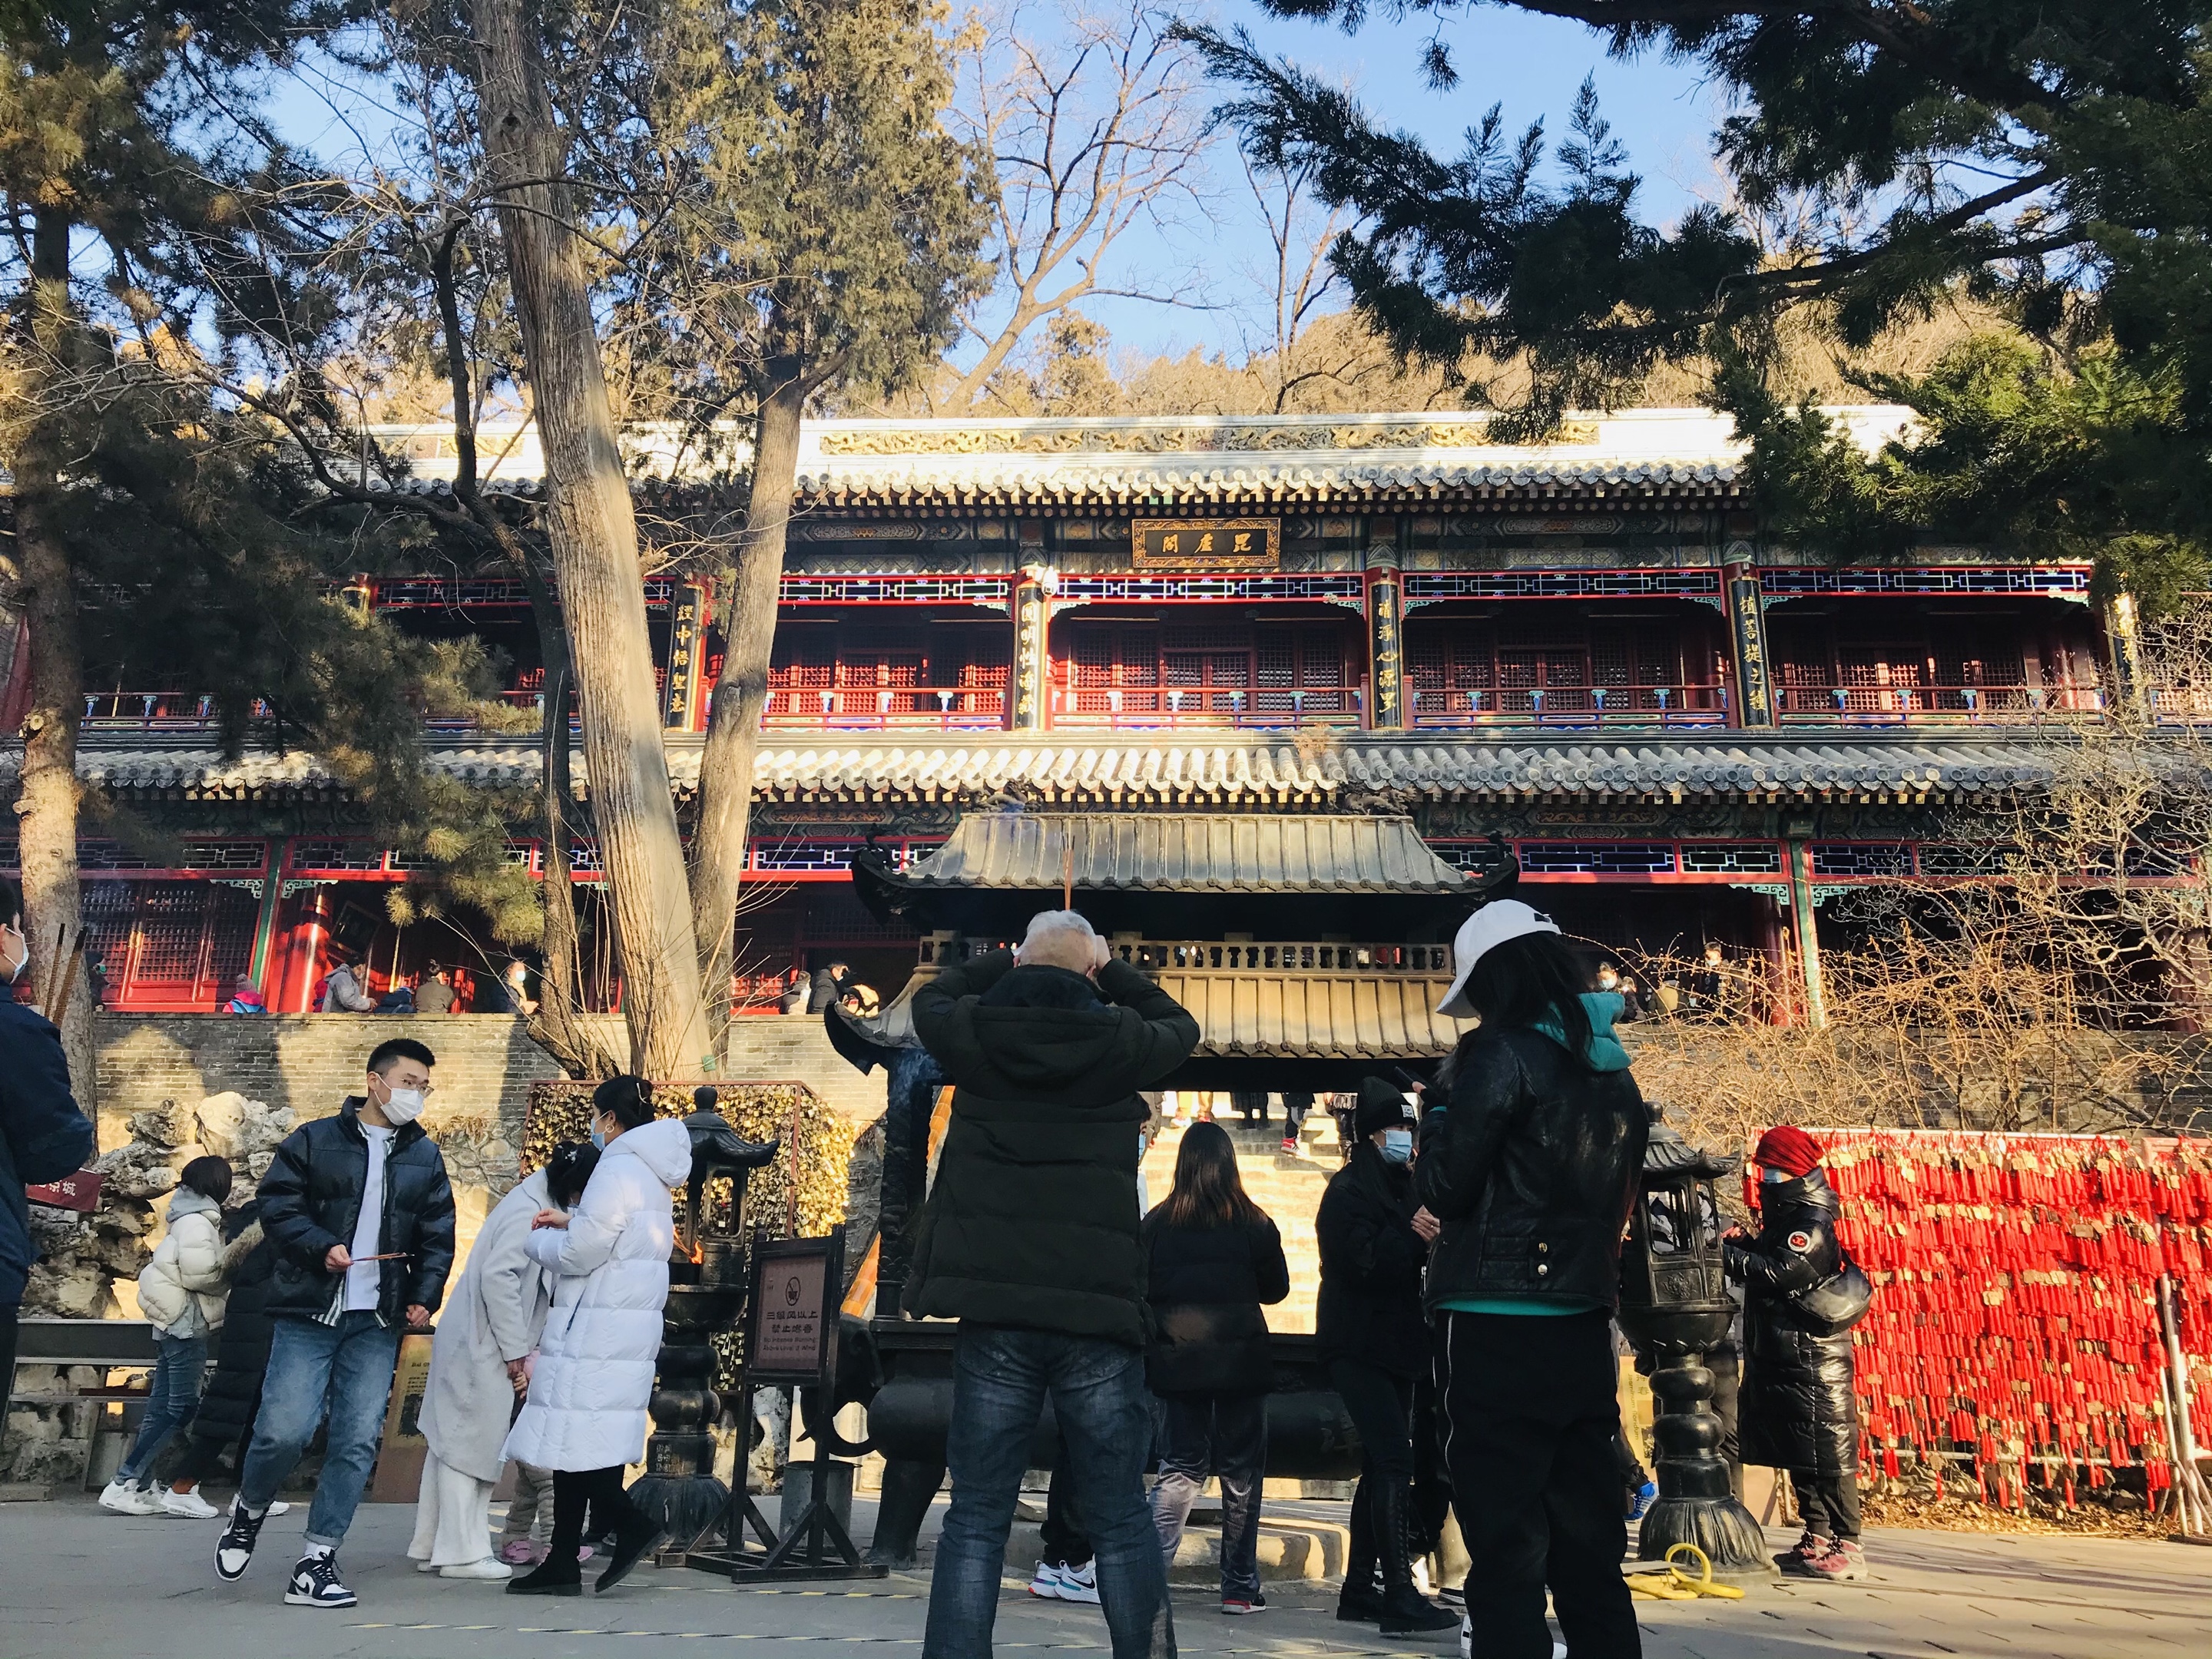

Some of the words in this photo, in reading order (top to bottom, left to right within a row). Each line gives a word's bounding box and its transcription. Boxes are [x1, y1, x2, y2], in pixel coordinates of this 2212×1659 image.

[1739, 595, 1767, 711] 植菩提之種
[35, 1180, 77, 1197] 京城
